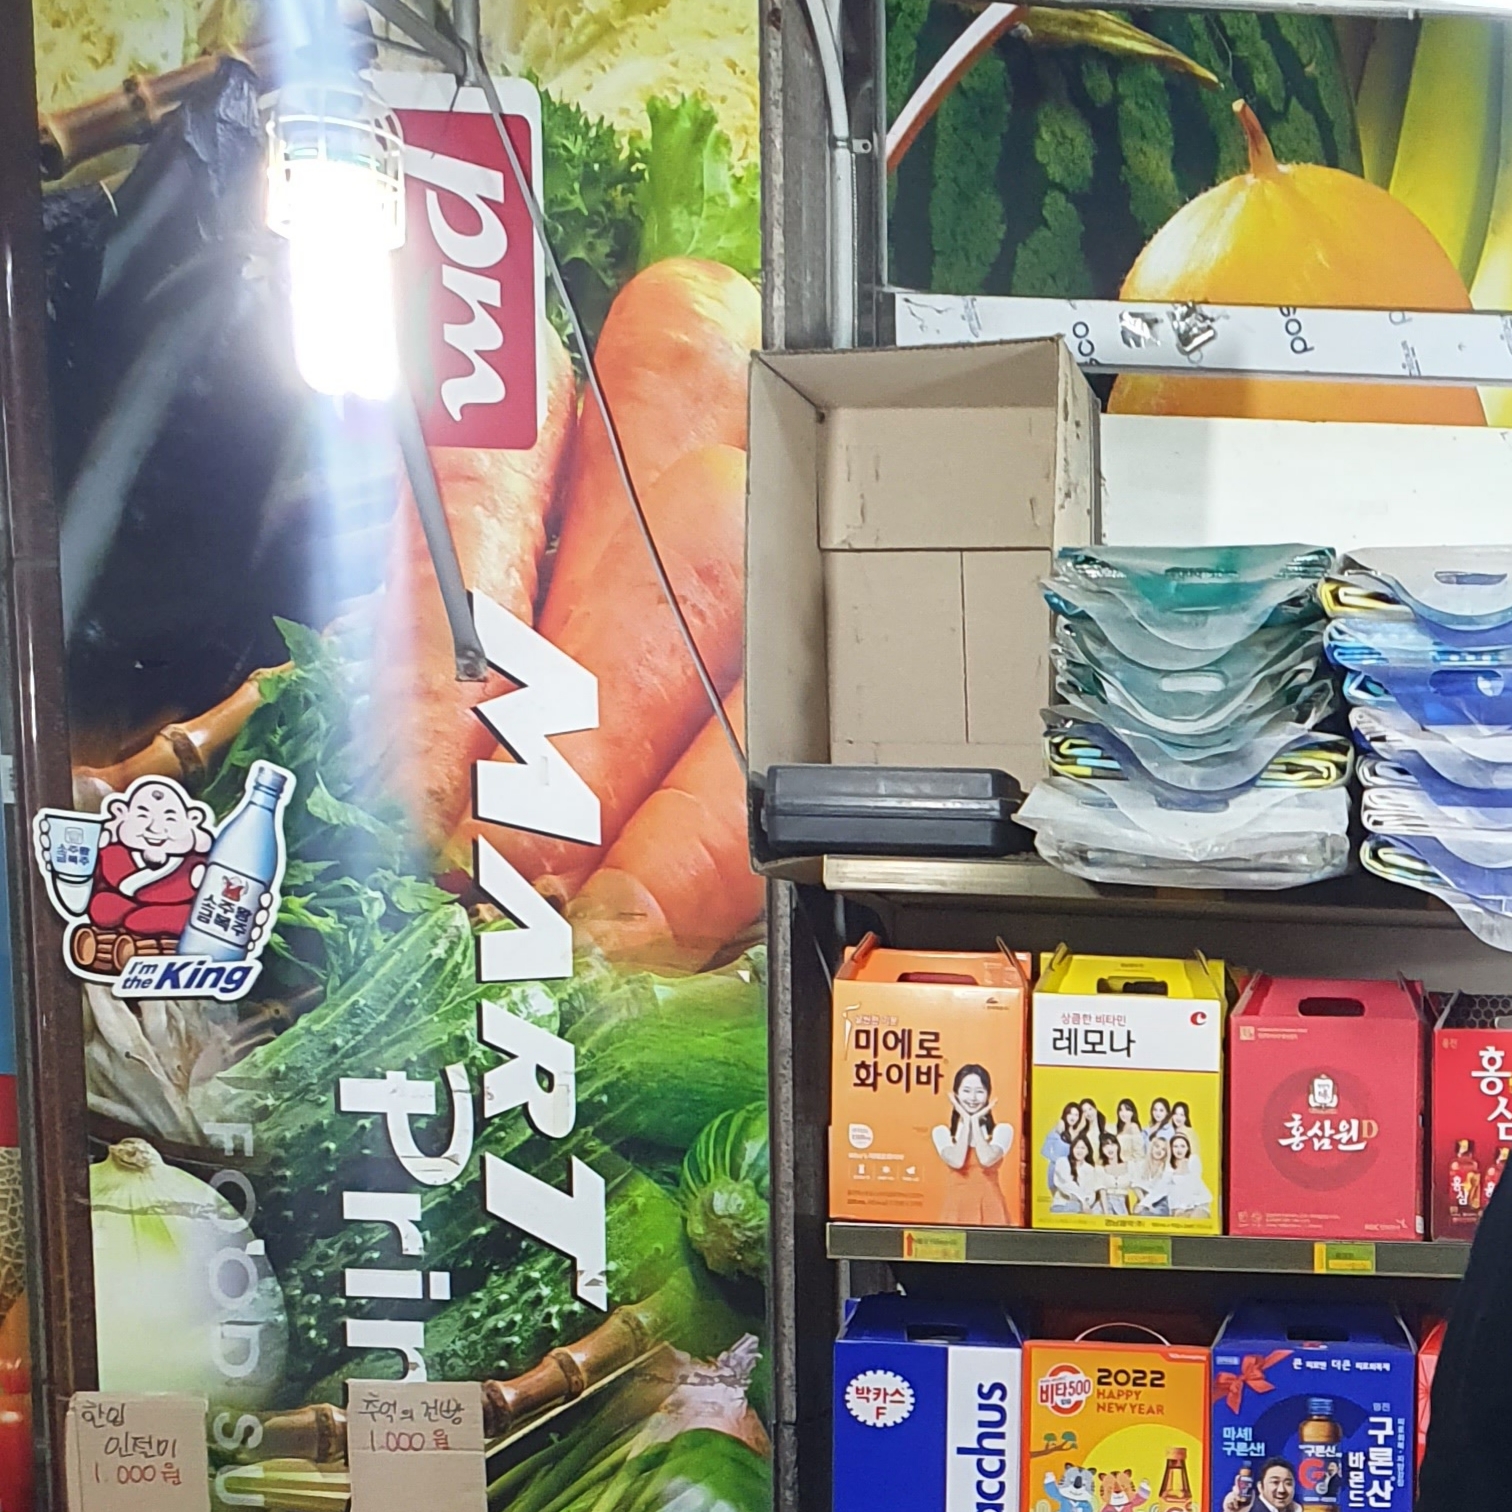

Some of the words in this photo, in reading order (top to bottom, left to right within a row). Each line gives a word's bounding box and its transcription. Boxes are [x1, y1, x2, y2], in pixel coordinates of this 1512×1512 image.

[474, 586, 609, 1312] MART
[120, 974, 153, 990] the
[128, 960, 158, 976] I'm
[153, 961, 253, 994] King
[1060, 1012, 1093, 1026] 상큼한
[1094, 1013, 1128, 1027] 비타민
[853, 1028, 944, 1061] 미에로
[1051, 1027, 1137, 1059] 레모나
[852, 1061, 945, 1095] 화이바
[338, 1060, 475, 1384] Prin
[203, 1122, 262, 1378] FOOD
[1039, 1378, 1092, 1405] 비타500
[1096, 1367, 1167, 1389] 2022
[358, 1392, 415, 1424] 추억의
[420, 1398, 466, 1426] 건빵
[855, 1385, 907, 1405] 박카스
[1096, 1388, 1143, 1401] HAPPY
[1096, 1402, 1129, 1414] NEW
[1128, 1402, 1165, 1416] YEAR
[875, 1406, 888, 1421] F
[1365, 1416, 1396, 1509] 구론산
[1347, 1450, 1366, 1508] 바몬드
